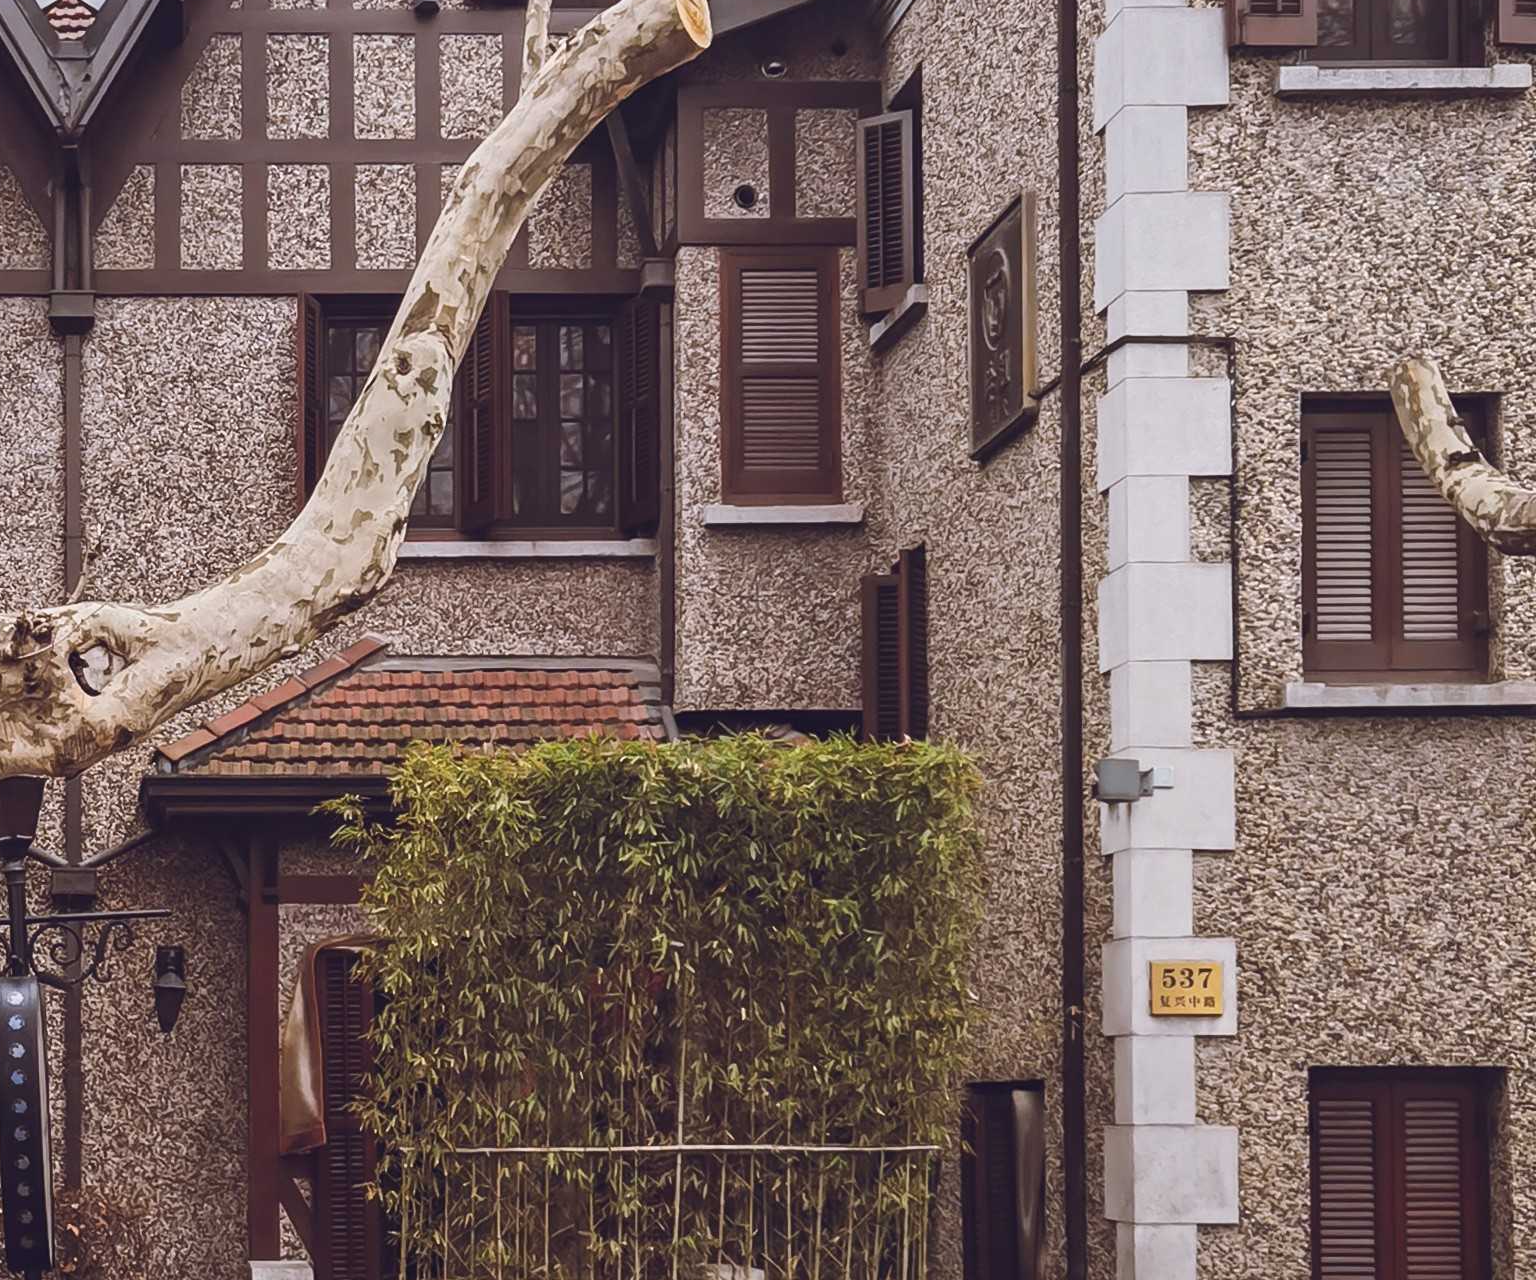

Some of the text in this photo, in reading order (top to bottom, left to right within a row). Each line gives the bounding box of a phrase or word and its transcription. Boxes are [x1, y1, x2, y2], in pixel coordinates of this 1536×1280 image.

[1161, 967, 1214, 989] 537
[1159, 995, 1216, 1009] 复兴中路
